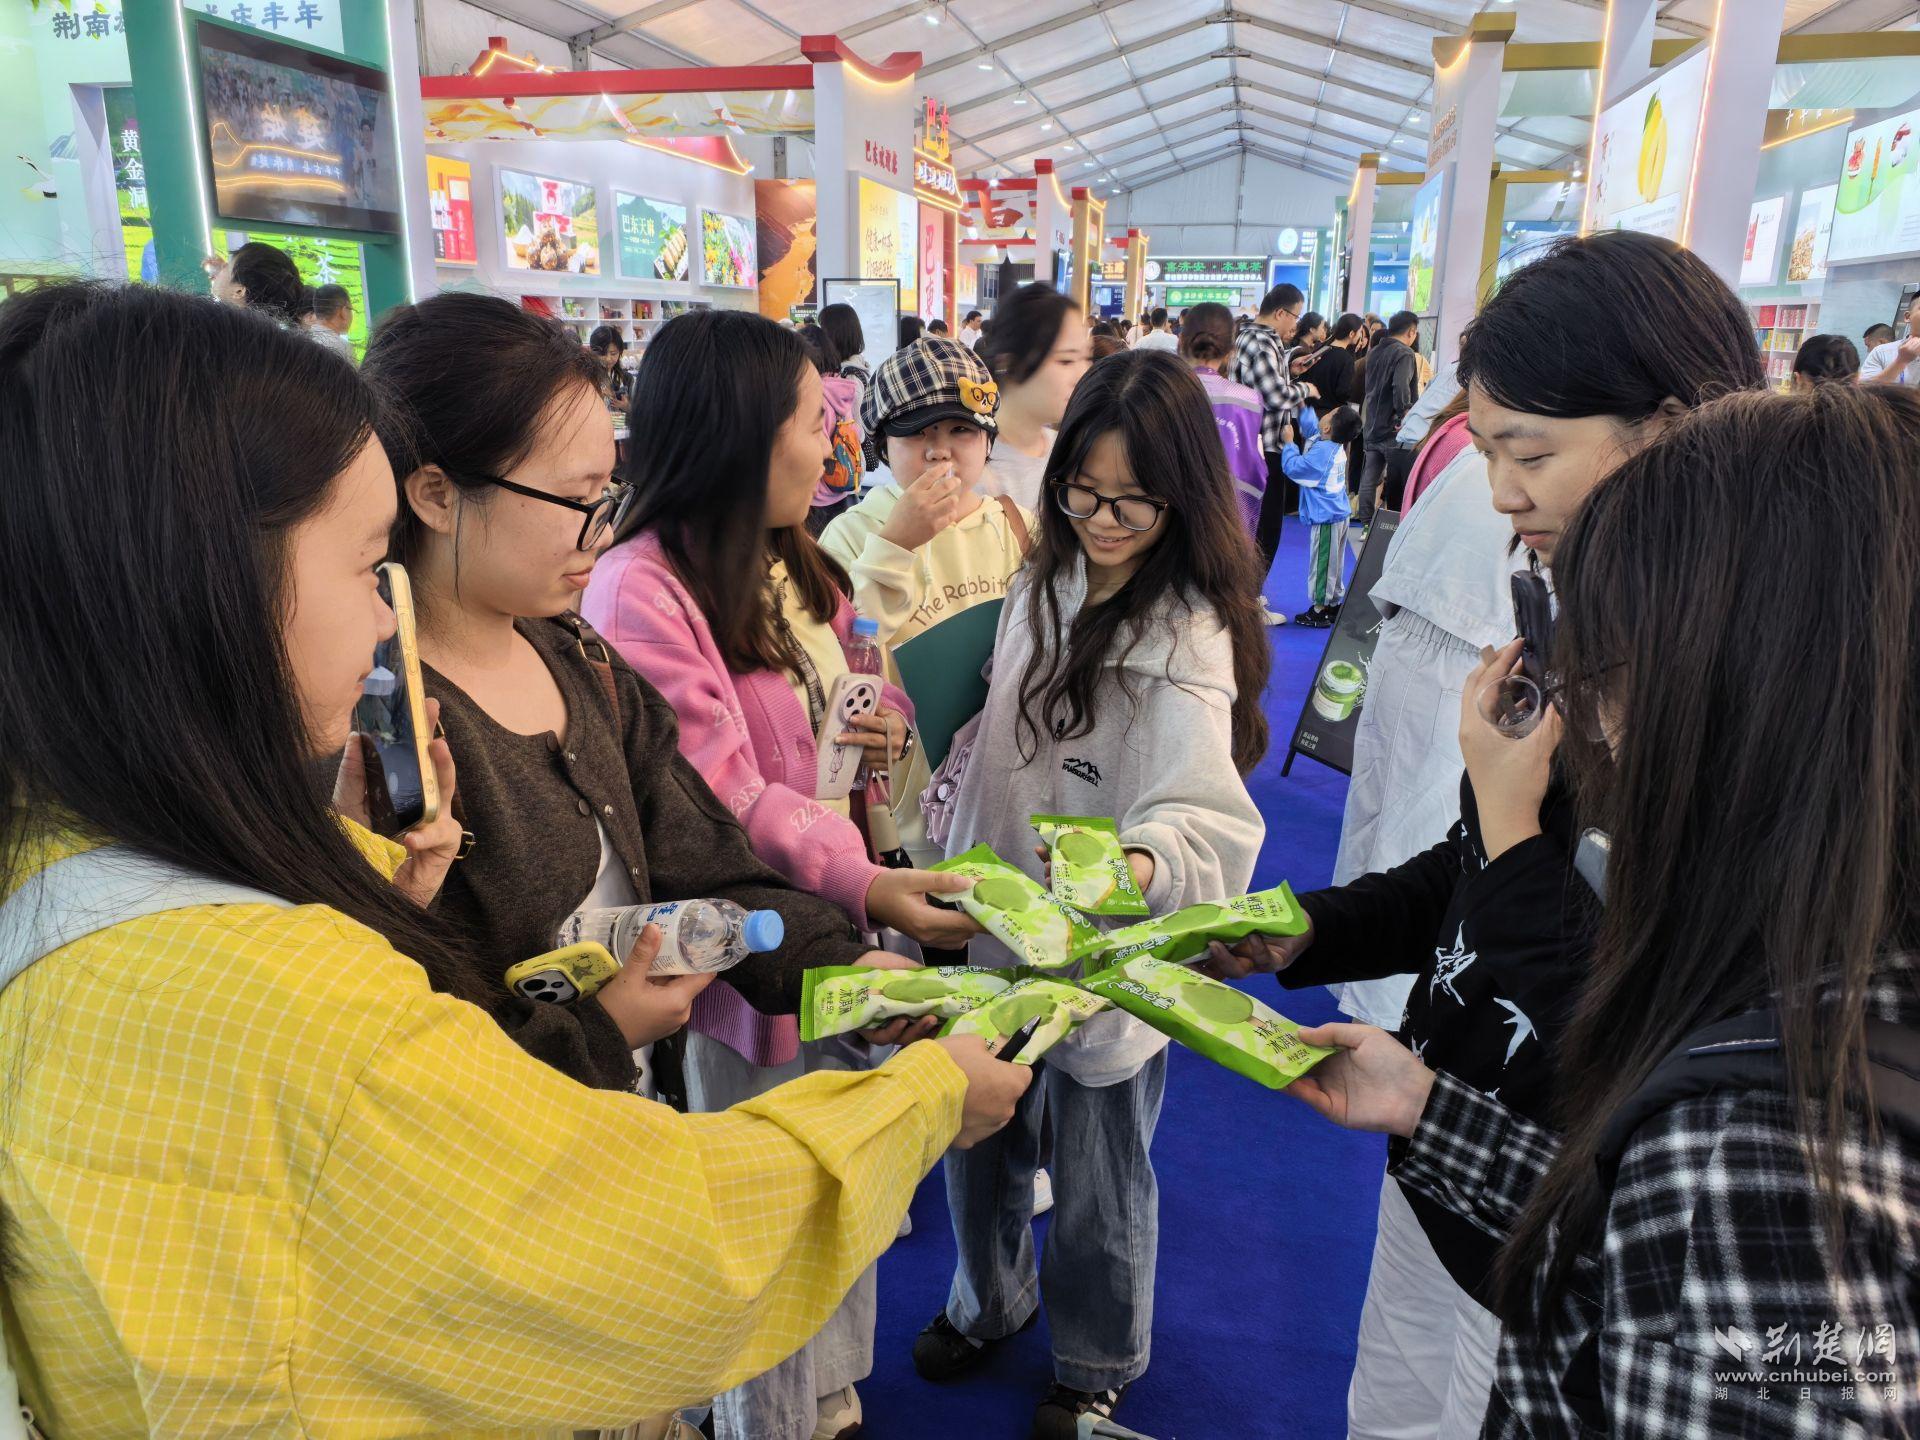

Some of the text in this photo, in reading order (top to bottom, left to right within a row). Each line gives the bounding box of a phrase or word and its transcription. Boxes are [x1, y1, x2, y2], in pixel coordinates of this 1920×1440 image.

[621, 213, 656, 238] 巴东天麻
[909, 597, 944, 626] The
